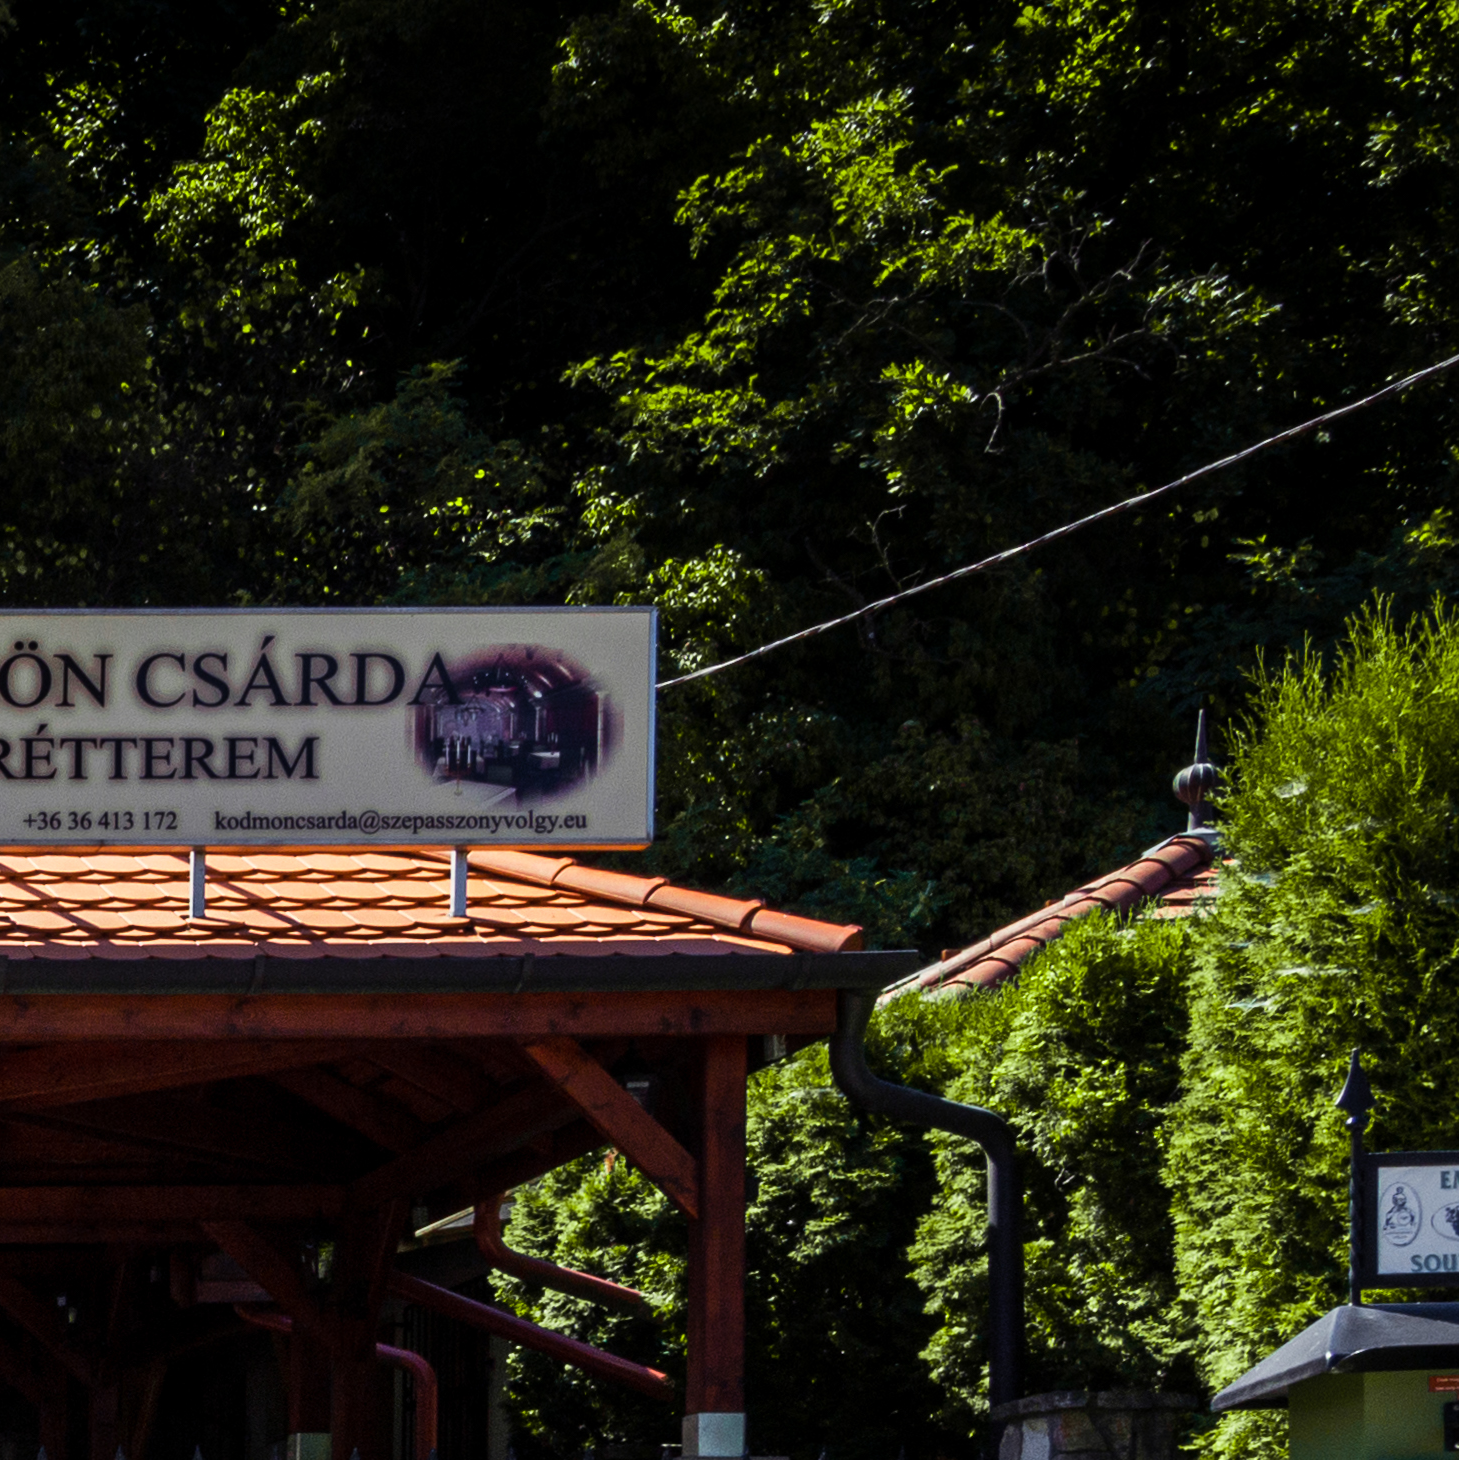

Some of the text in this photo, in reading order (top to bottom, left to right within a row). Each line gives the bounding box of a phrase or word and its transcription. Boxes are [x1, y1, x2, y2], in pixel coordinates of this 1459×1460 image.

[135, 635, 462, 708] CSÁRDA
[22, 811, 61, 831] +36
[67, 811, 93, 831] 36
[97, 811, 135, 831] 413
[142, 811, 179, 831] 172
[214, 810, 588, 835] kodmoncsarda@szepasszonyvolgy.eu
[1410, 1253, 1459, 1273] SOU
